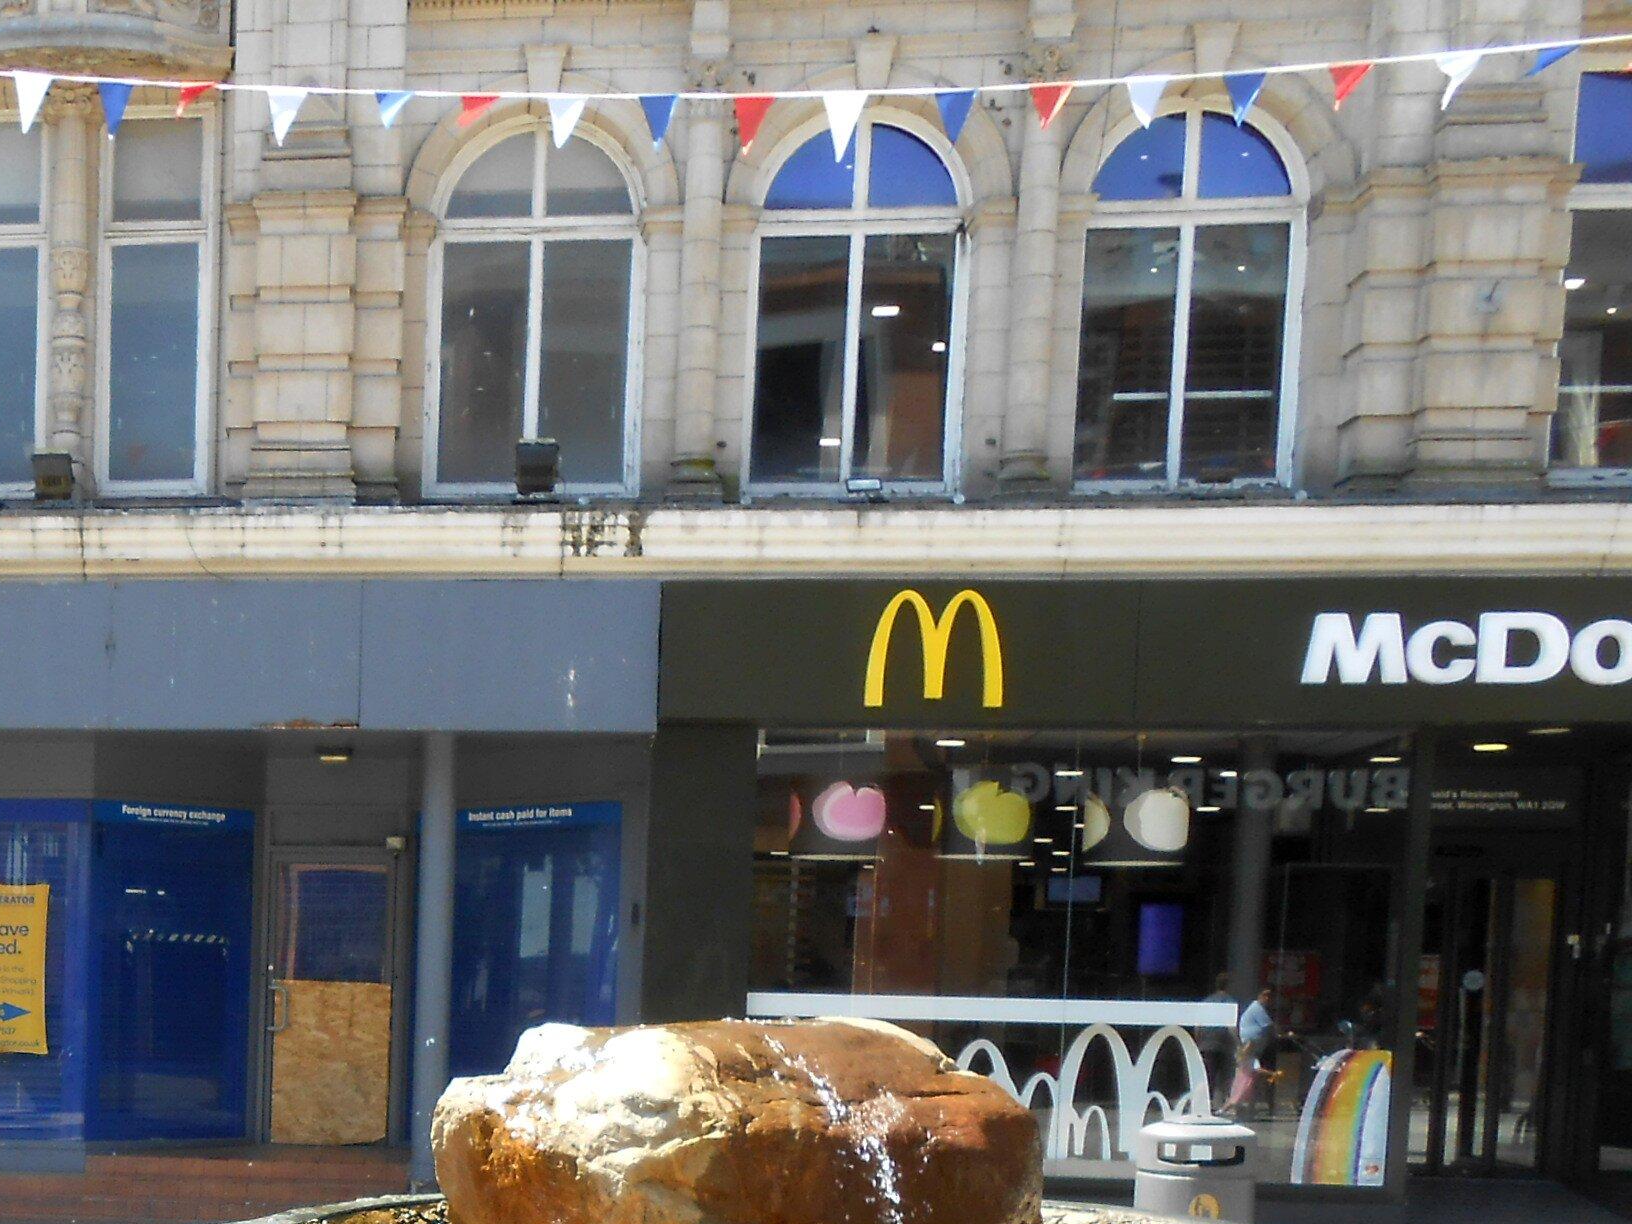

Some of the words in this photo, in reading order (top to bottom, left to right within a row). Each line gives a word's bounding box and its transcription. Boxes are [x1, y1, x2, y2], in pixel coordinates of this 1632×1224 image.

[121, 804, 152, 818] Foreign
[153, 807, 187, 820] currency
[188, 809, 226, 823] exchange
[468, 810, 494, 822] Instant
[495, 809, 515, 820] cash
[516, 808, 534, 821] paid
[535, 808, 547, 818] for
[548, 807, 572, 818] items
